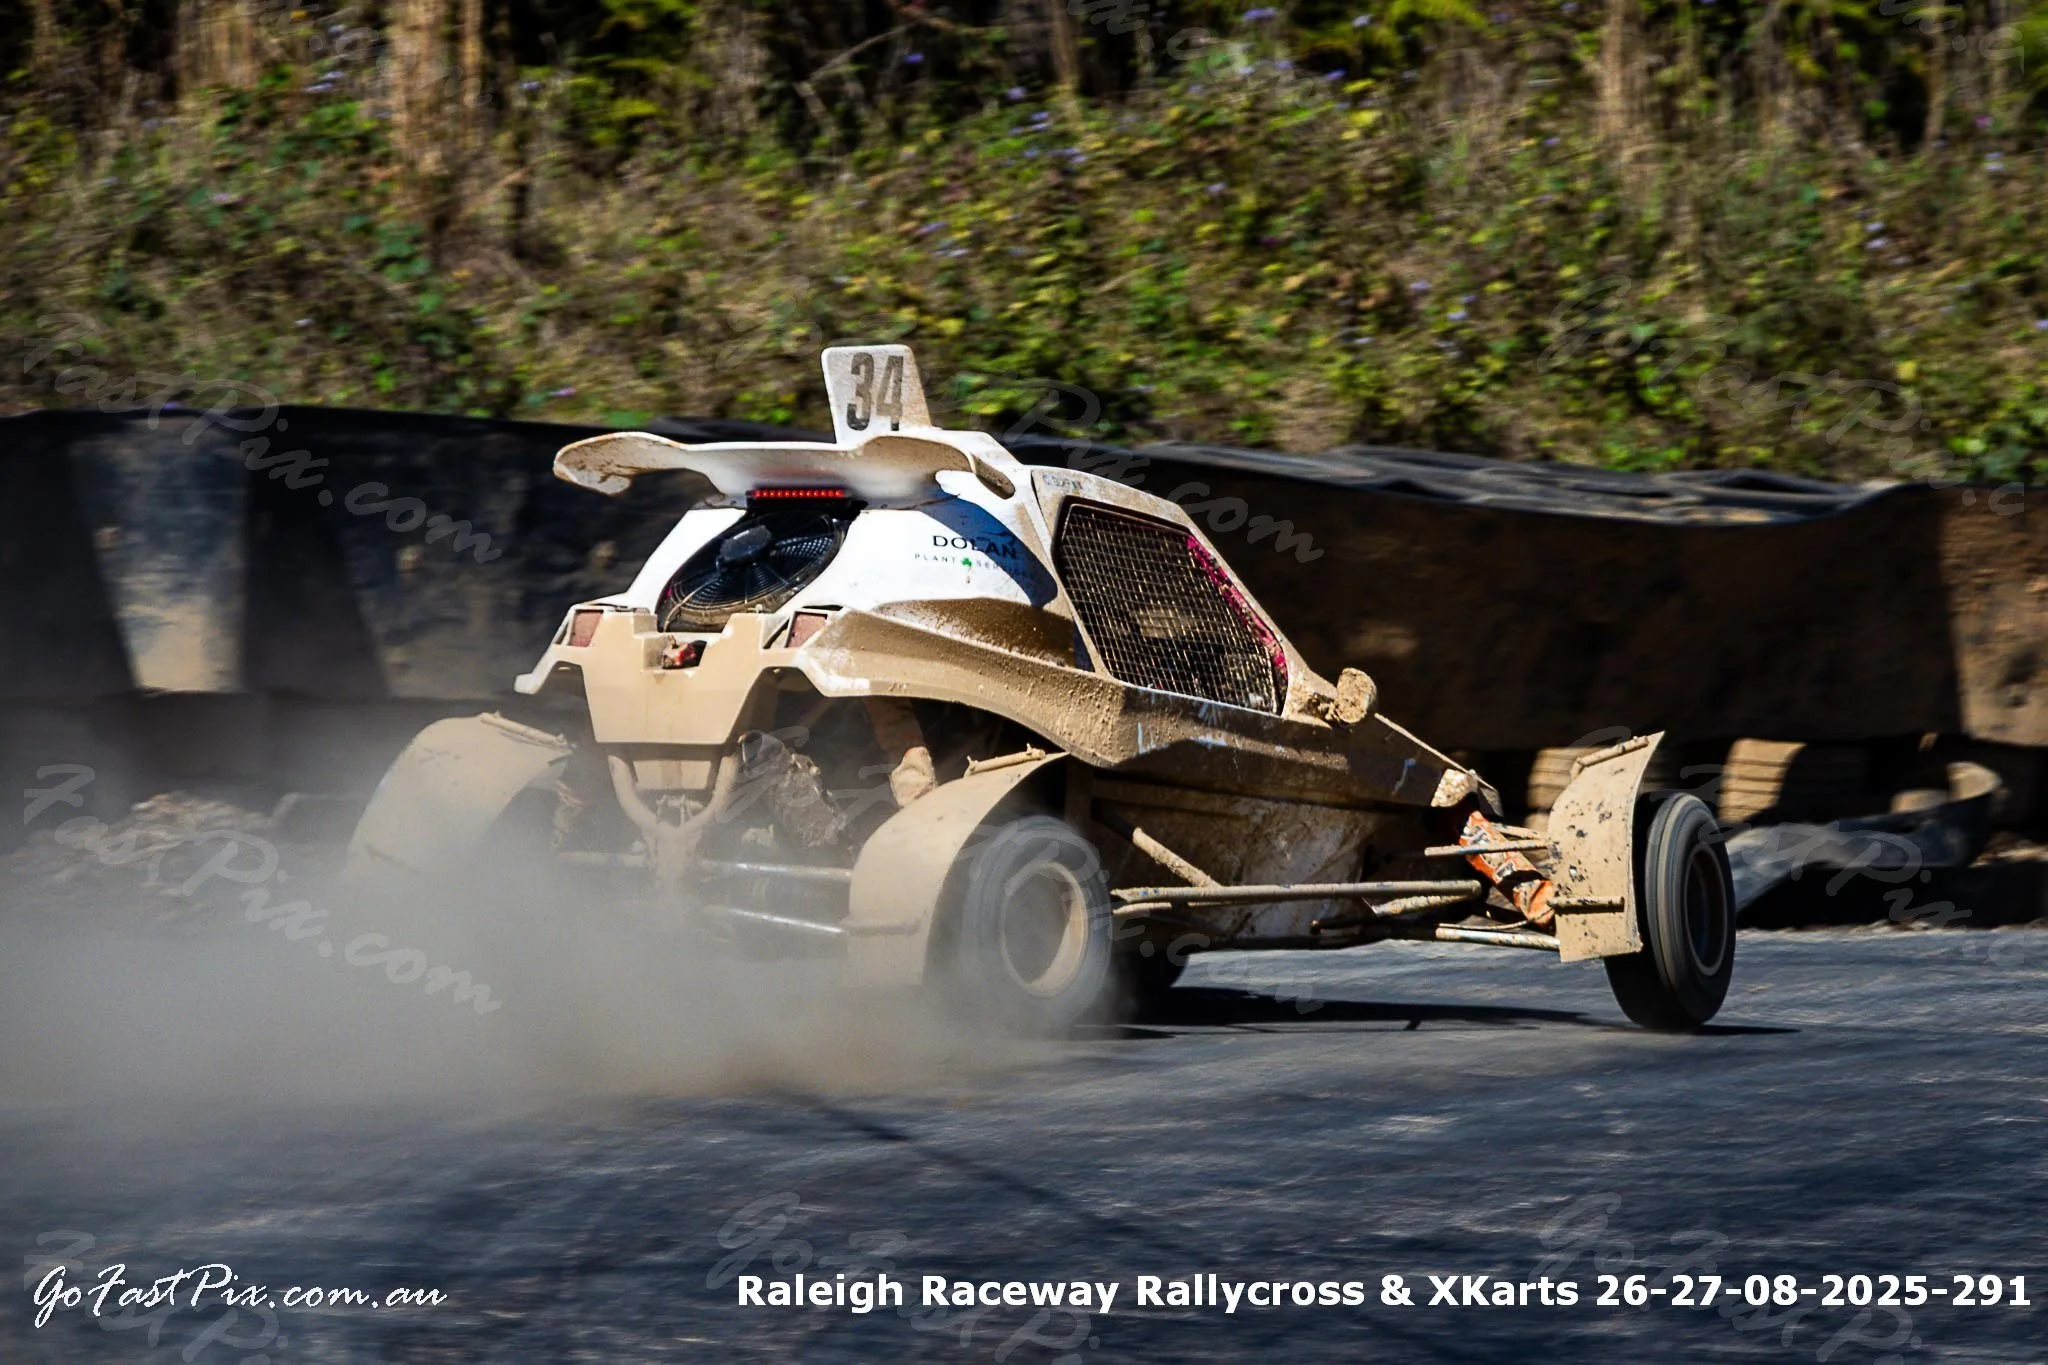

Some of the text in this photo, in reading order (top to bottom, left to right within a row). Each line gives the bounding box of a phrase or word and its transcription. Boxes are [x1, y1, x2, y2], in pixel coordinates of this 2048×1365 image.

[846, 352, 904, 431] 34
[914, 553, 957, 563] PLANT
[932, 535, 1017, 560] DOLAN
